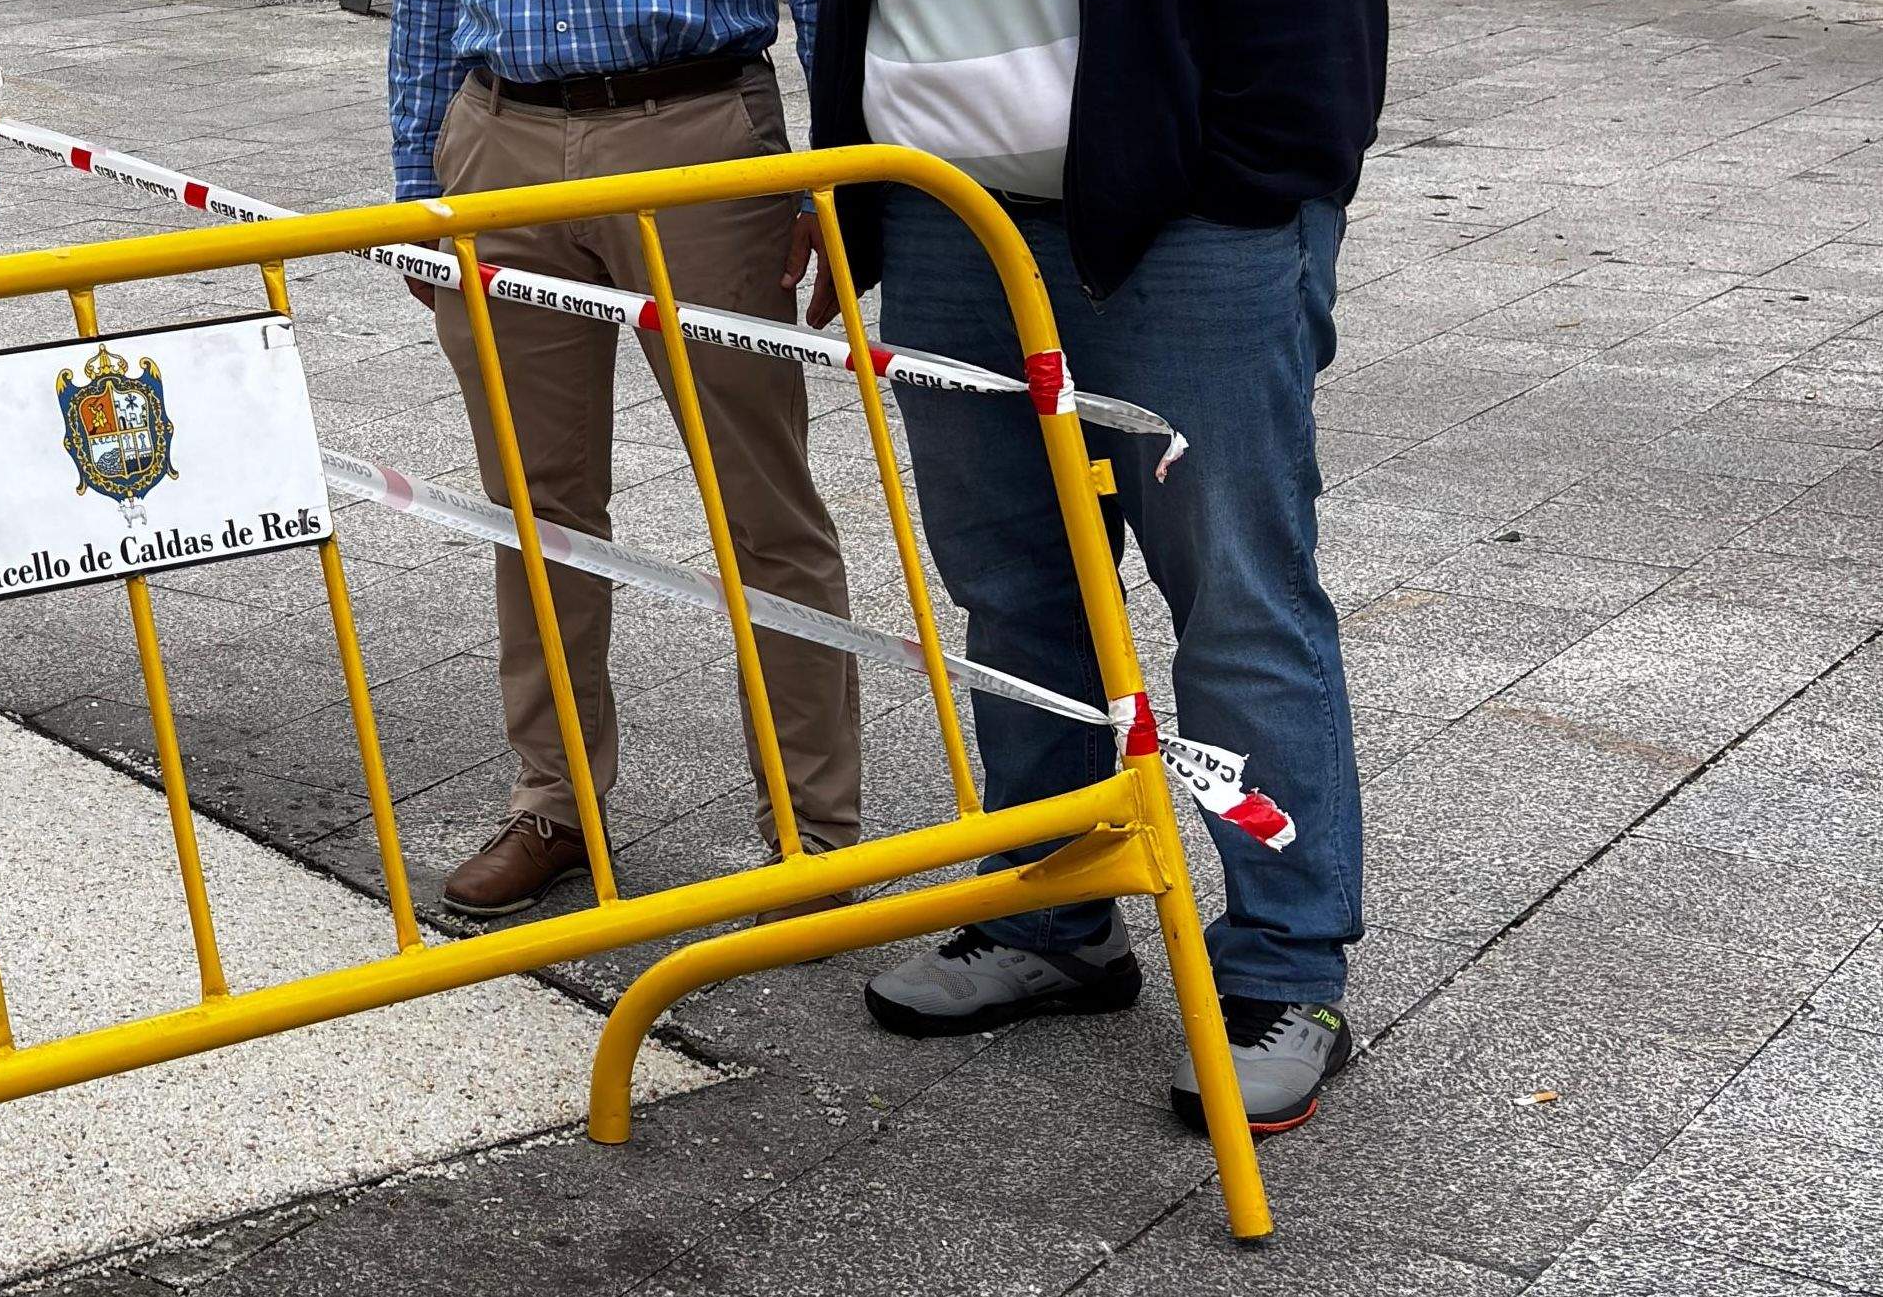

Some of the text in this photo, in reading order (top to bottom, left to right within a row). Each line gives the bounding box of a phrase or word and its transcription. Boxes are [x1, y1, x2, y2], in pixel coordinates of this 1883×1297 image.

[94, 164, 178, 201] CALDAS DE REIS
[211, 200, 236, 218] REIS
[239, 208, 254, 223] DE
[375, 247, 394, 266] DE
[396, 253, 451, 282] CALDAS
[497, 279, 626, 323] CALDAS DE REIS
[681, 321, 832, 367] CALDAS DE REIS
[895, 368, 942, 390] REIS
[81, 542, 113, 573] de
[120, 527, 214, 566] Caldas
[222, 518, 254, 548] de
